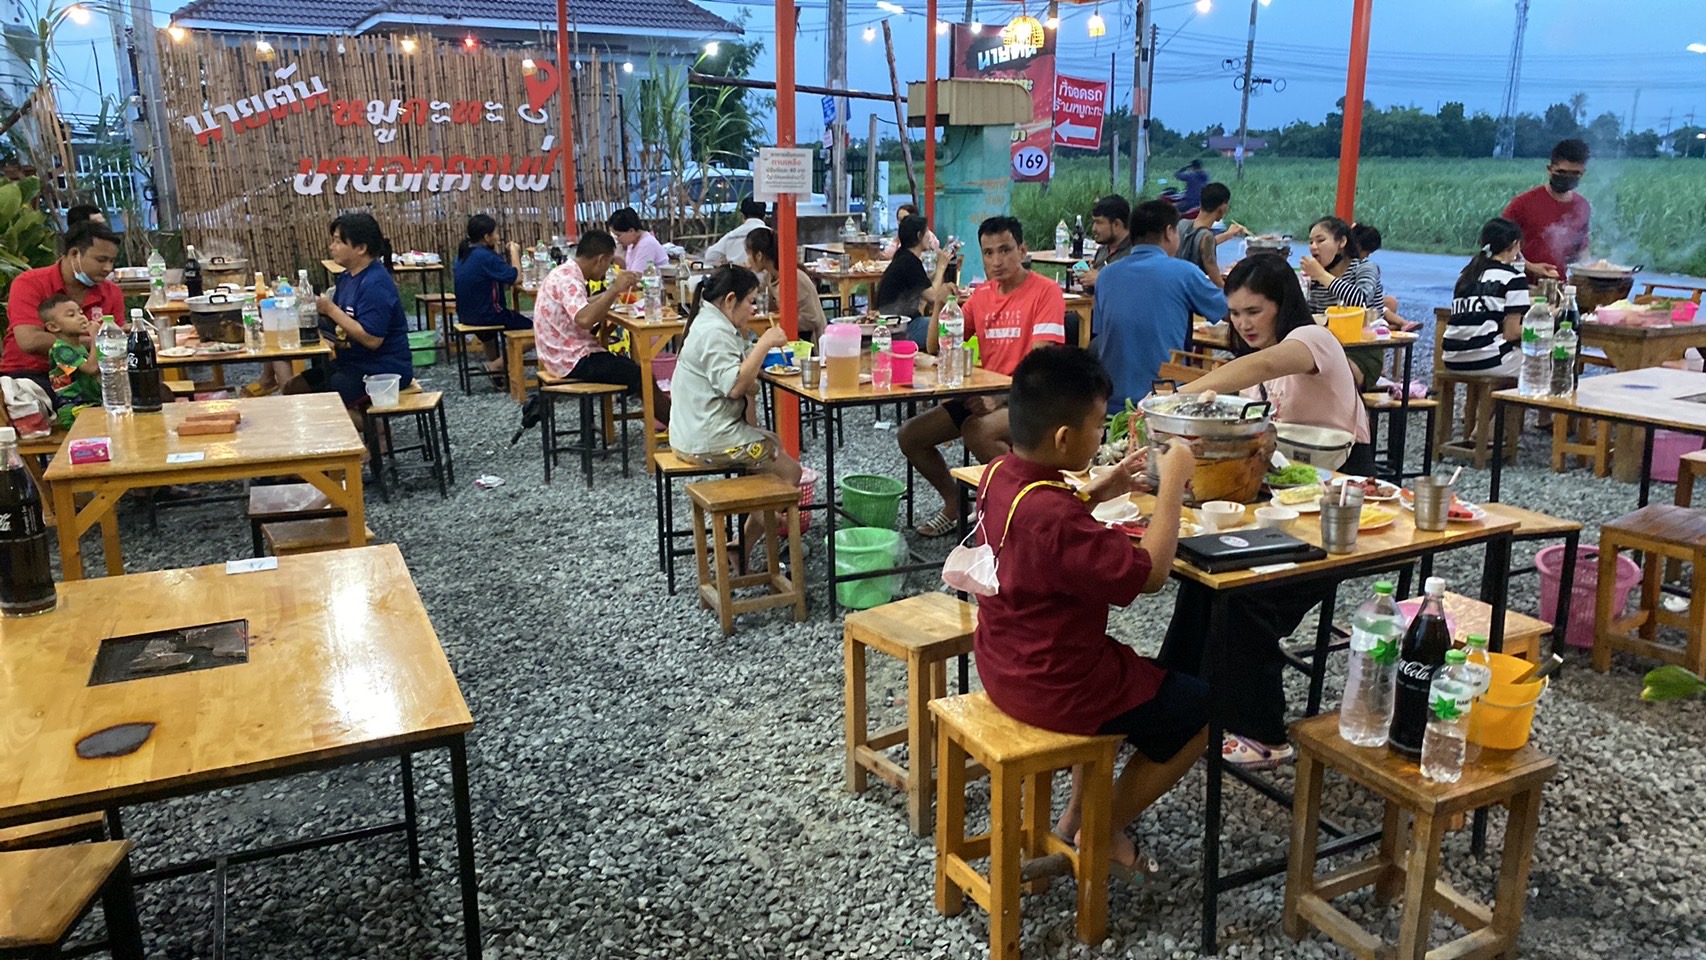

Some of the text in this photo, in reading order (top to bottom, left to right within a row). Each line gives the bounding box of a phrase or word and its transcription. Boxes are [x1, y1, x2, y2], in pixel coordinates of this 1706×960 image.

[1059, 79, 1103, 102] ที่จอดรถ
[1018, 154, 1044, 169] 169
